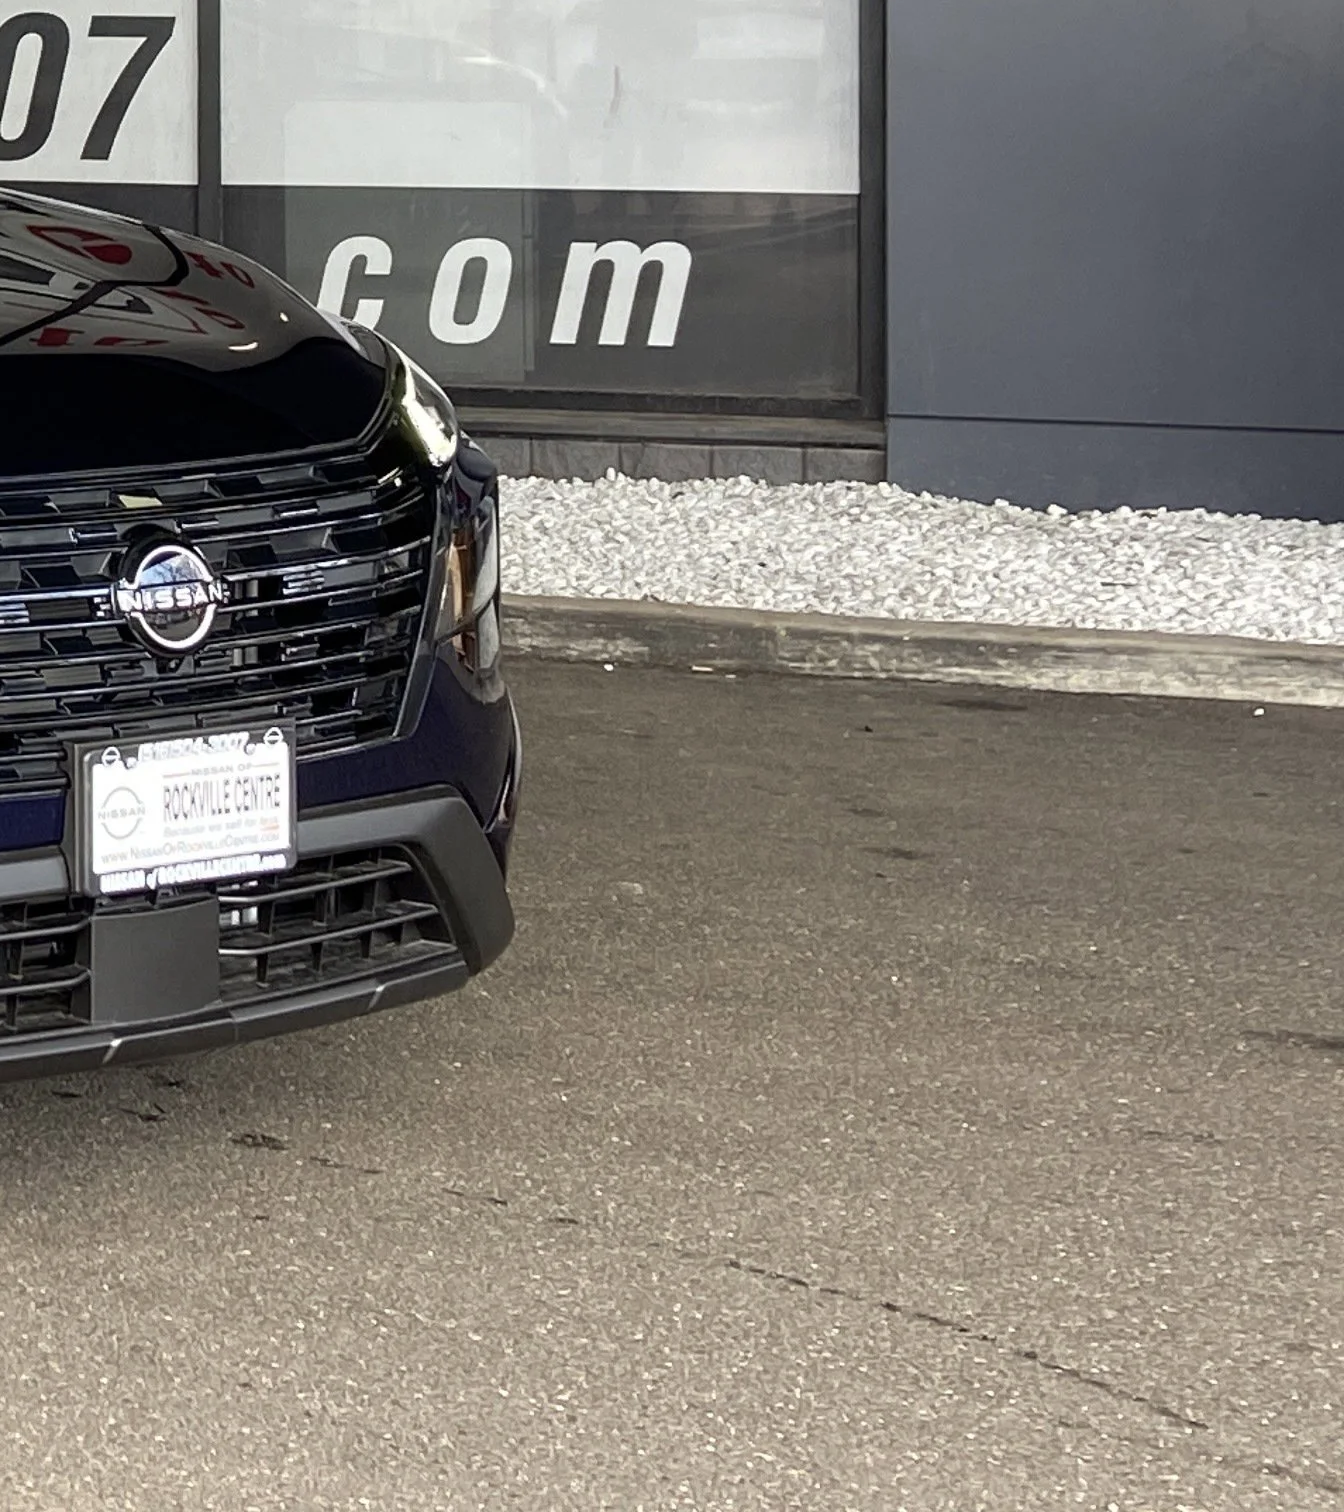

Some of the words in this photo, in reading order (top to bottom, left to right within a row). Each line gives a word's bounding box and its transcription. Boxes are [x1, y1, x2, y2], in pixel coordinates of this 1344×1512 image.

[116, 580, 223, 613] NISSAN
[97, 805, 146, 820] NISSAN
[163, 778, 230, 822] ROCKVILLE
[234, 773, 281, 813] CENTRE
